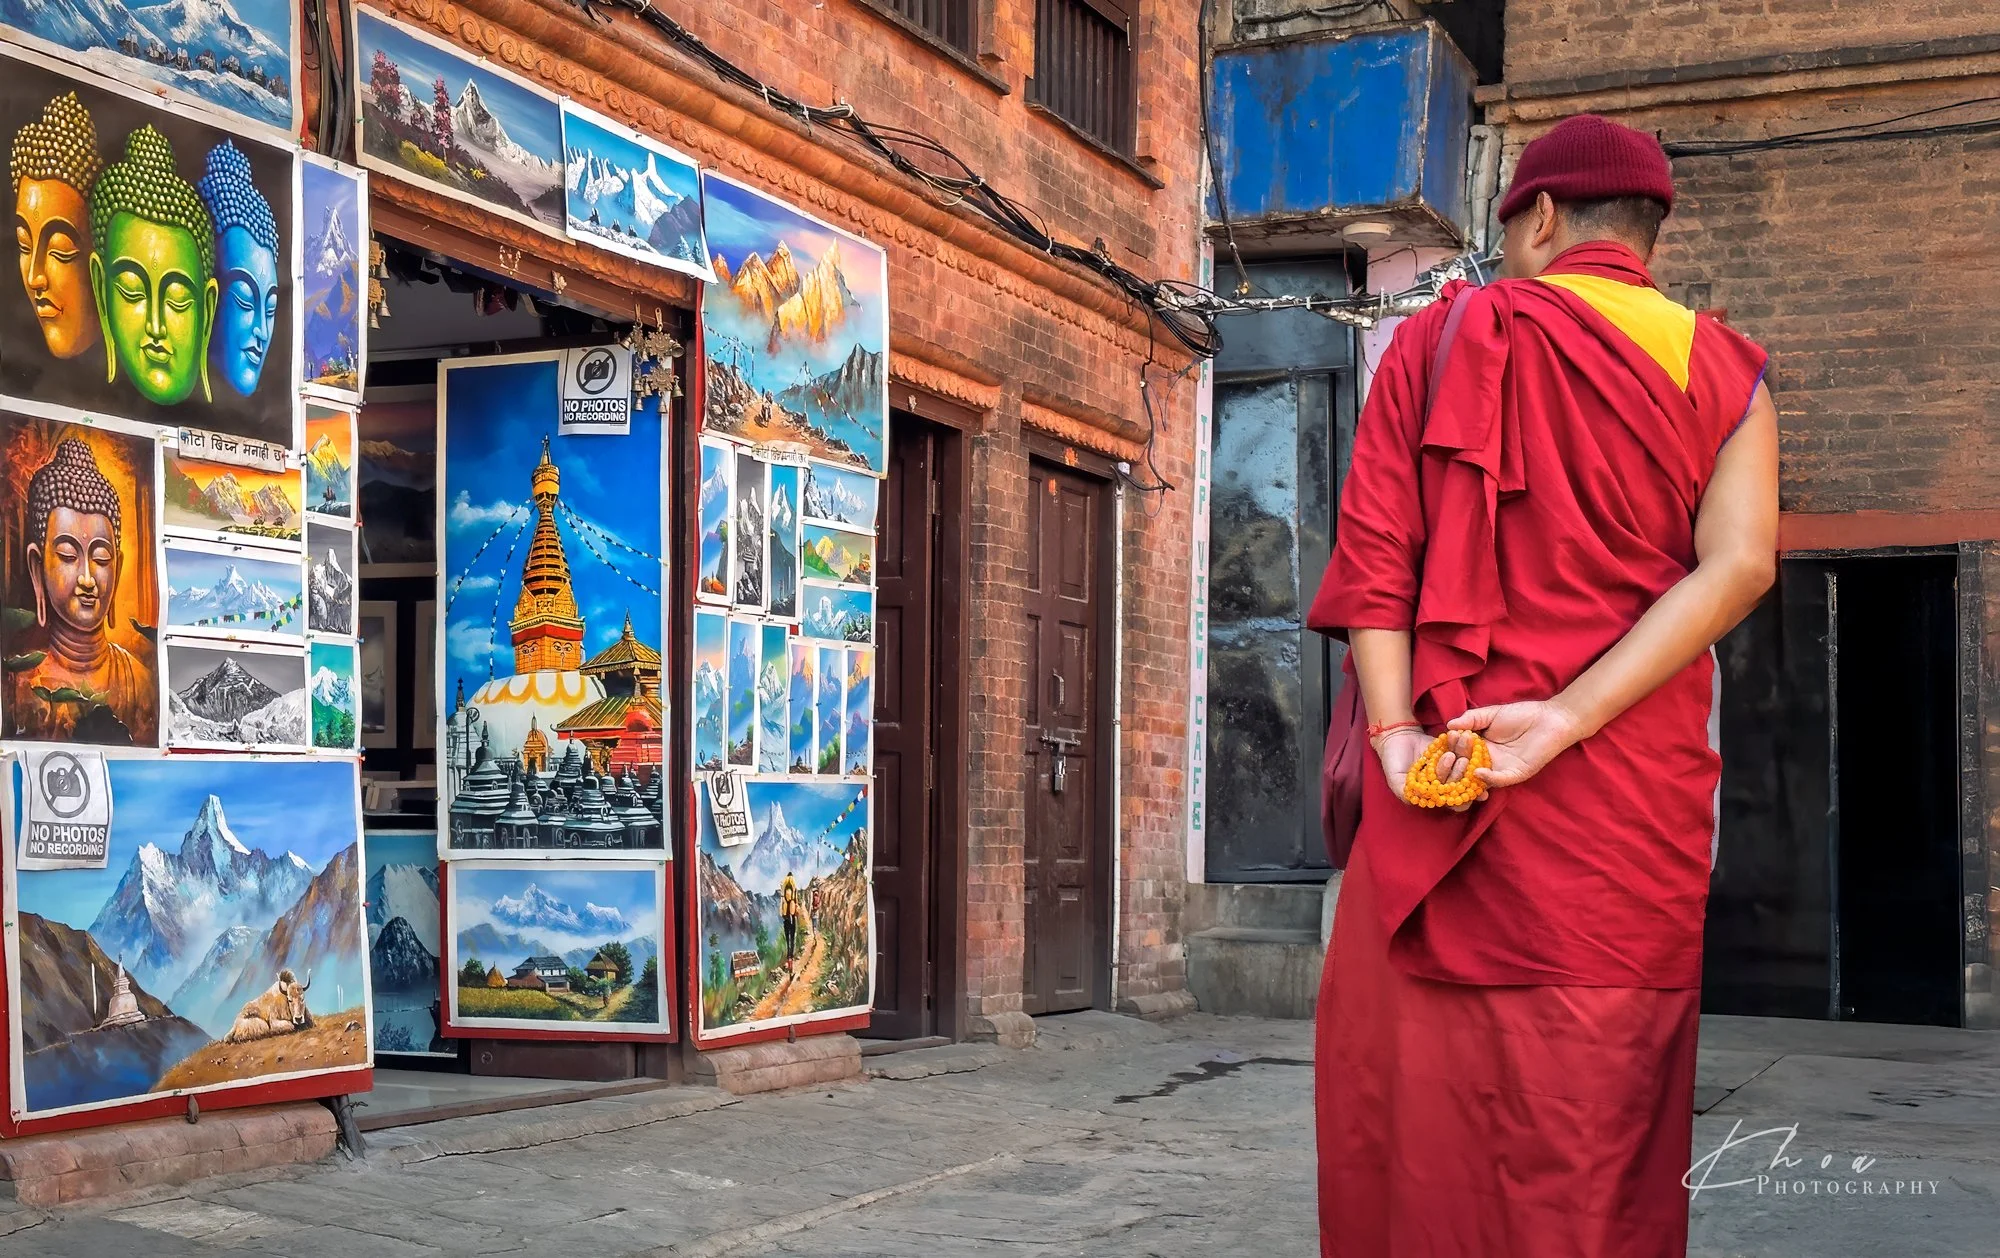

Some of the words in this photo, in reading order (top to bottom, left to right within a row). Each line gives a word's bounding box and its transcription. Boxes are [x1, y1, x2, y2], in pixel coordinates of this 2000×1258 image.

[1201, 257, 1210, 389] RF
[564, 401, 579, 412] NO
[581, 400, 627, 412] PHOTOS
[563, 412, 575, 421] NO
[575, 412, 626, 421] RECORDING
[243, 442, 269, 461] मनाही
[1199, 415, 1208, 516] TOP
[1195, 541, 1205, 670] VIEW
[1192, 696, 1204, 831] CAFE
[720, 813, 746, 827] PHOTOS
[31, 824, 50, 841] NO
[53, 825, 106, 844] PHOTOS
[30, 842, 45, 853] NO
[47, 842, 104, 855] RECORDING
